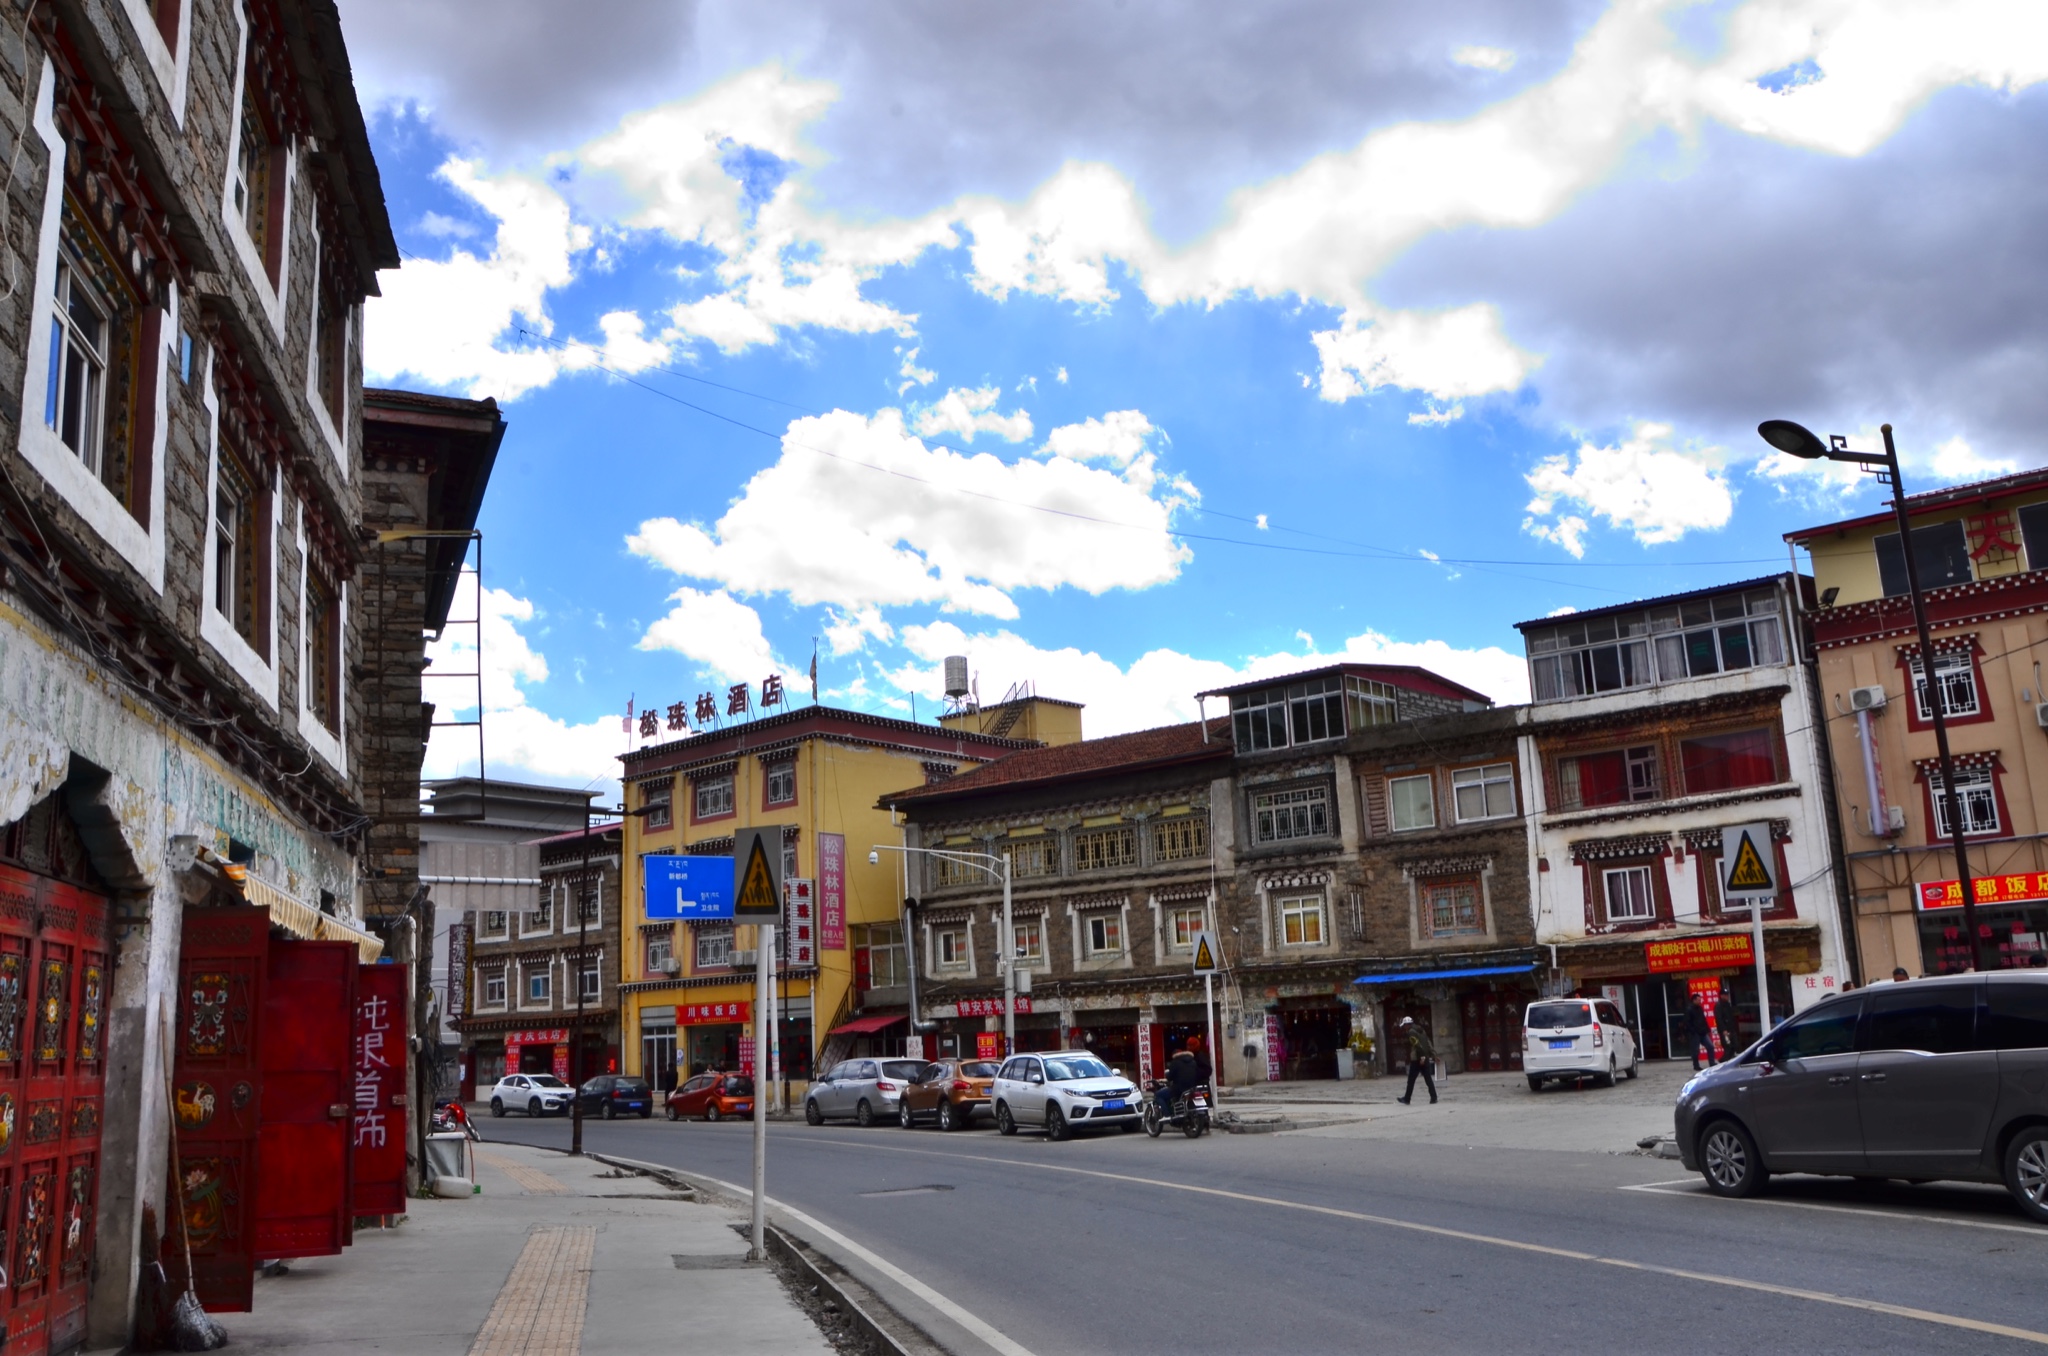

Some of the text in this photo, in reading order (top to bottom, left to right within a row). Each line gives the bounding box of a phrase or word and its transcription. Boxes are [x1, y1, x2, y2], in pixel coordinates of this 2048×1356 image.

[639, 674, 782, 739] 松珠林酒店
[824, 837, 840, 928] 松珠林酒店
[701, 904, 720, 912] 卫生院
[1649, 936, 1748, 957] 成都好口福川菜馆
[1805, 976, 1834, 989] 住宿
[688, 1004, 737, 1018] 川味饭店
[960, 998, 1028, 1012] 雅安家常馆
[512, 1029, 561, 1042] 重庆饭店
